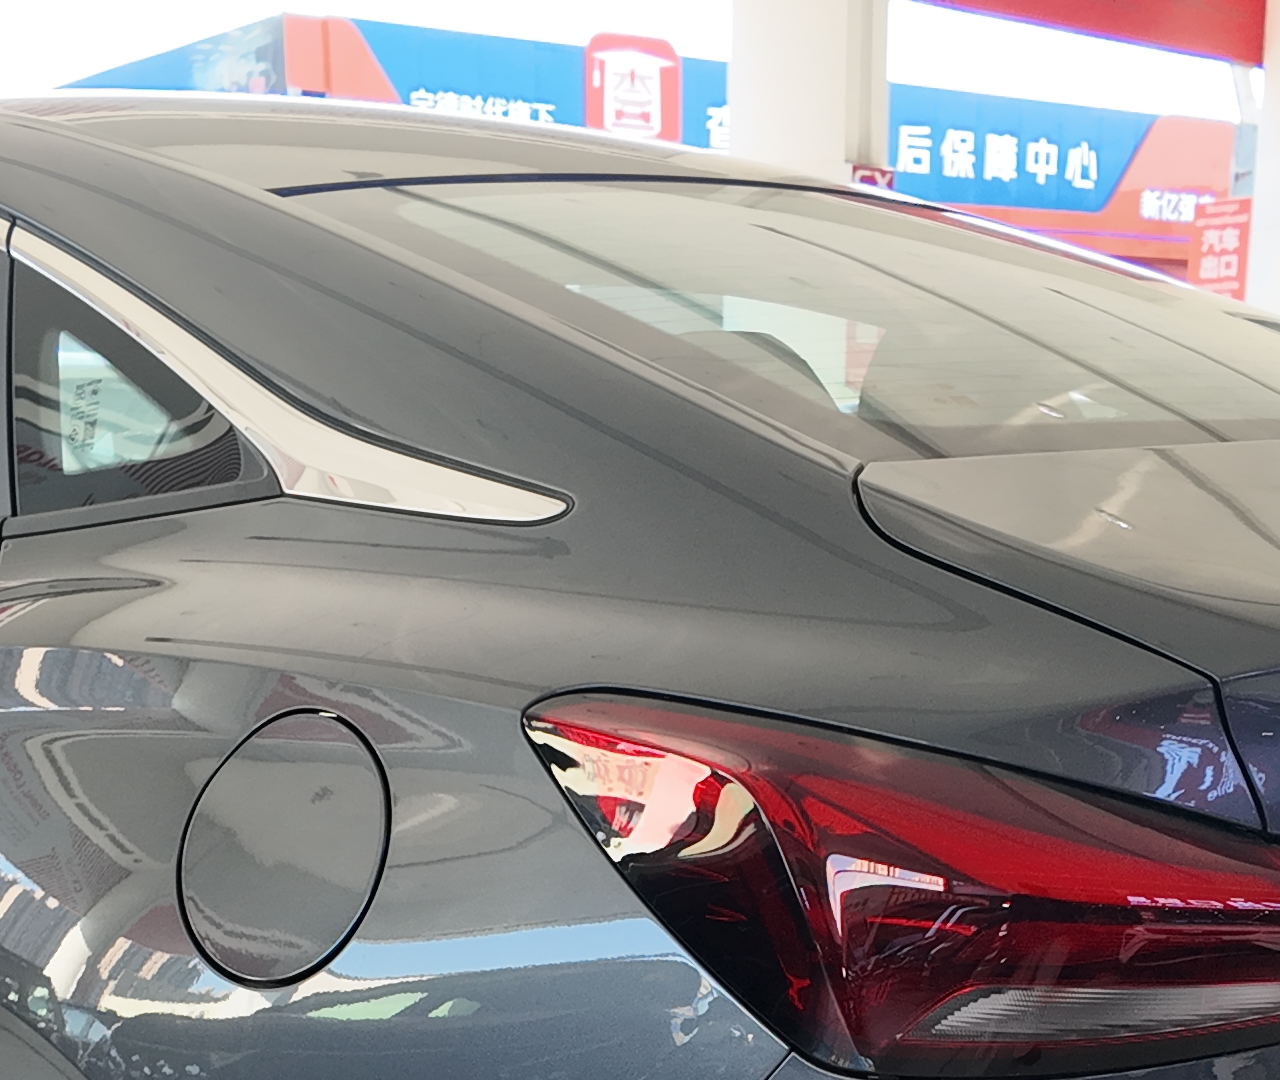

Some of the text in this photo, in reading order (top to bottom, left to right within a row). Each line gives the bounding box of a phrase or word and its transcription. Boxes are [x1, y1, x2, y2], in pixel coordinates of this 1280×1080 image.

[896, 124, 1099, 190] 后保障中心
